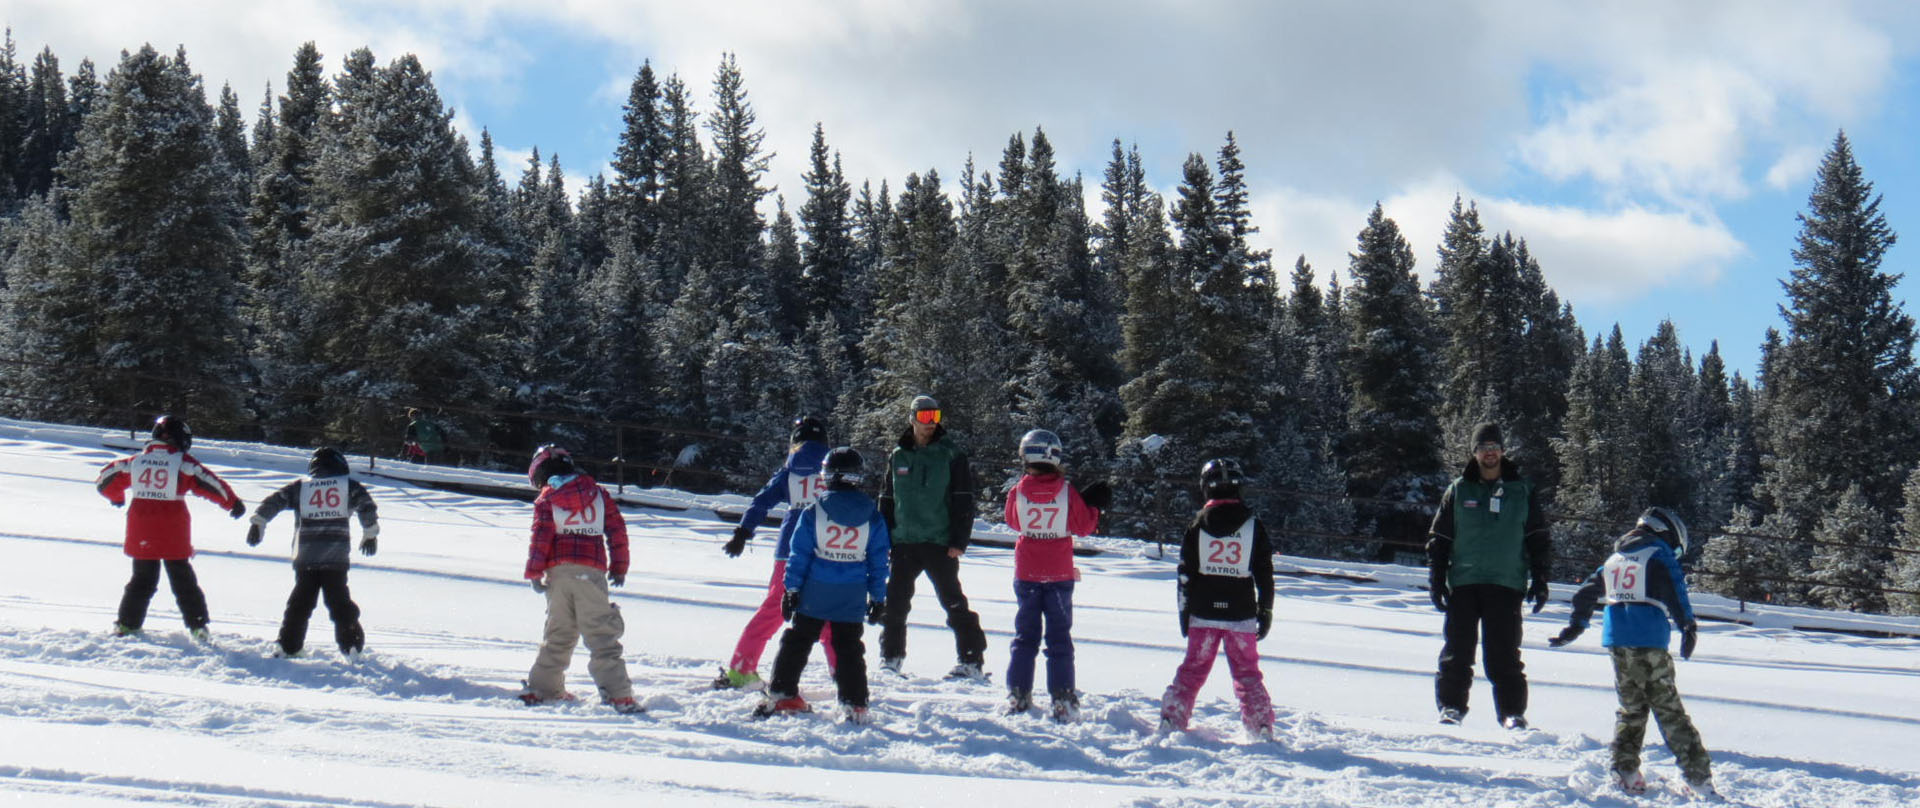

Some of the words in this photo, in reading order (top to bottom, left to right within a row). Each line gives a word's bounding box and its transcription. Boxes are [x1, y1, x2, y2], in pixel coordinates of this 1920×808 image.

[138, 467, 169, 489] 49
[310, 479, 338, 487] PANDA
[798, 477, 828, 499] 15
[309, 487, 341, 509] 46
[1027, 507, 1060, 529] 27
[826, 525, 859, 549] 22
[1208, 540, 1242, 565] 23
[1206, 566, 1240, 575] PATROL
[1611, 565, 1637, 589] 15
